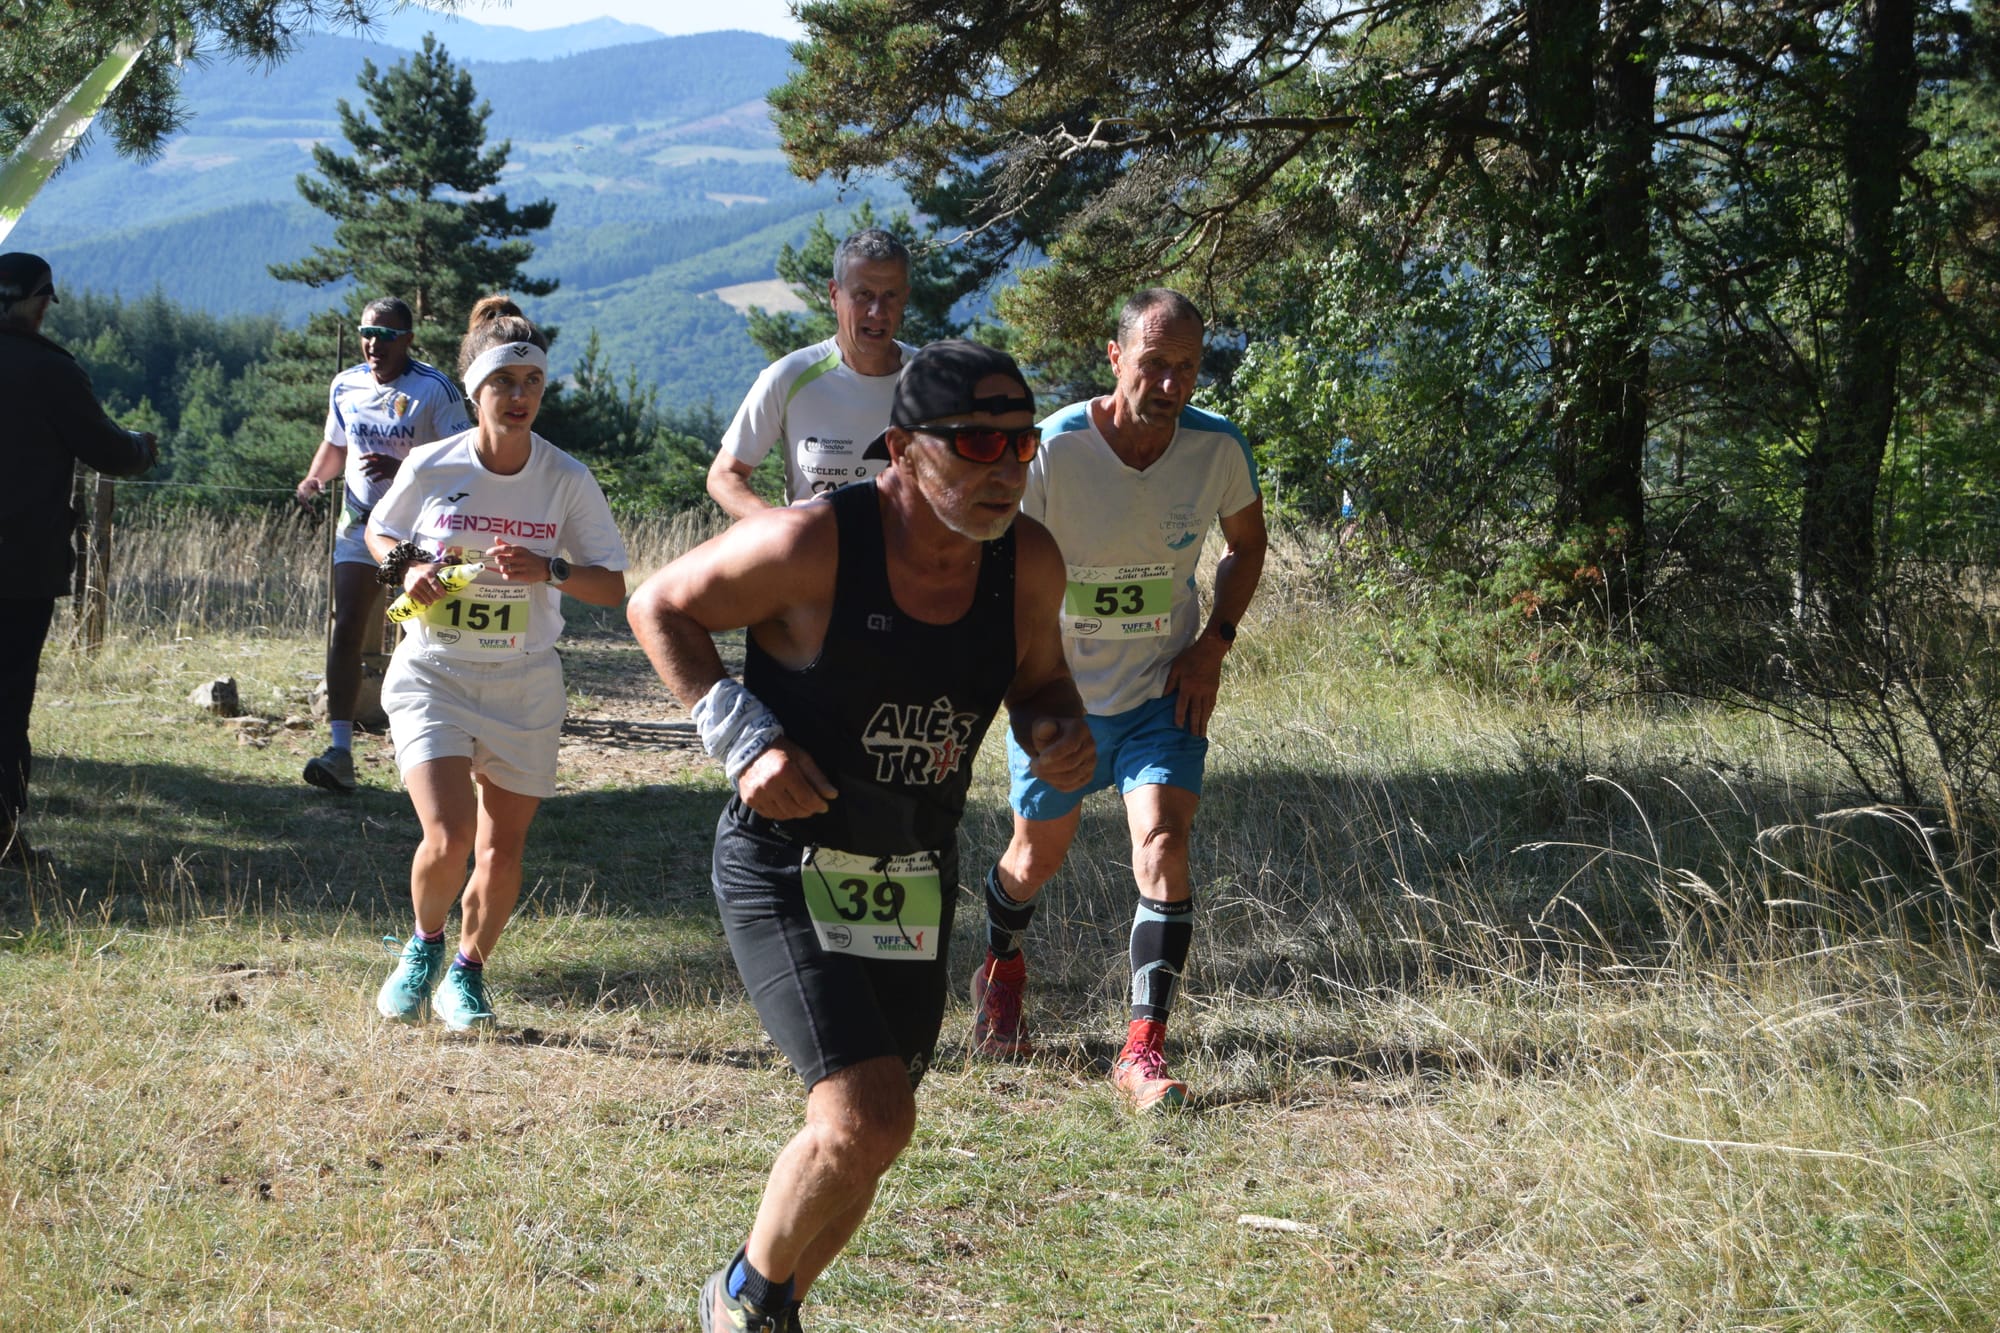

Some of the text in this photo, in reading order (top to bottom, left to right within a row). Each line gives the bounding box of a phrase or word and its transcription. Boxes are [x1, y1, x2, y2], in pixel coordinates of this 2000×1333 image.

[347, 422, 415, 439] ARAVAN
[433, 513, 557, 539] MENDEKIDEN
[445, 599, 511, 631] 151
[1094, 585, 1145, 616] 53
[839, 878, 906, 922] 39
